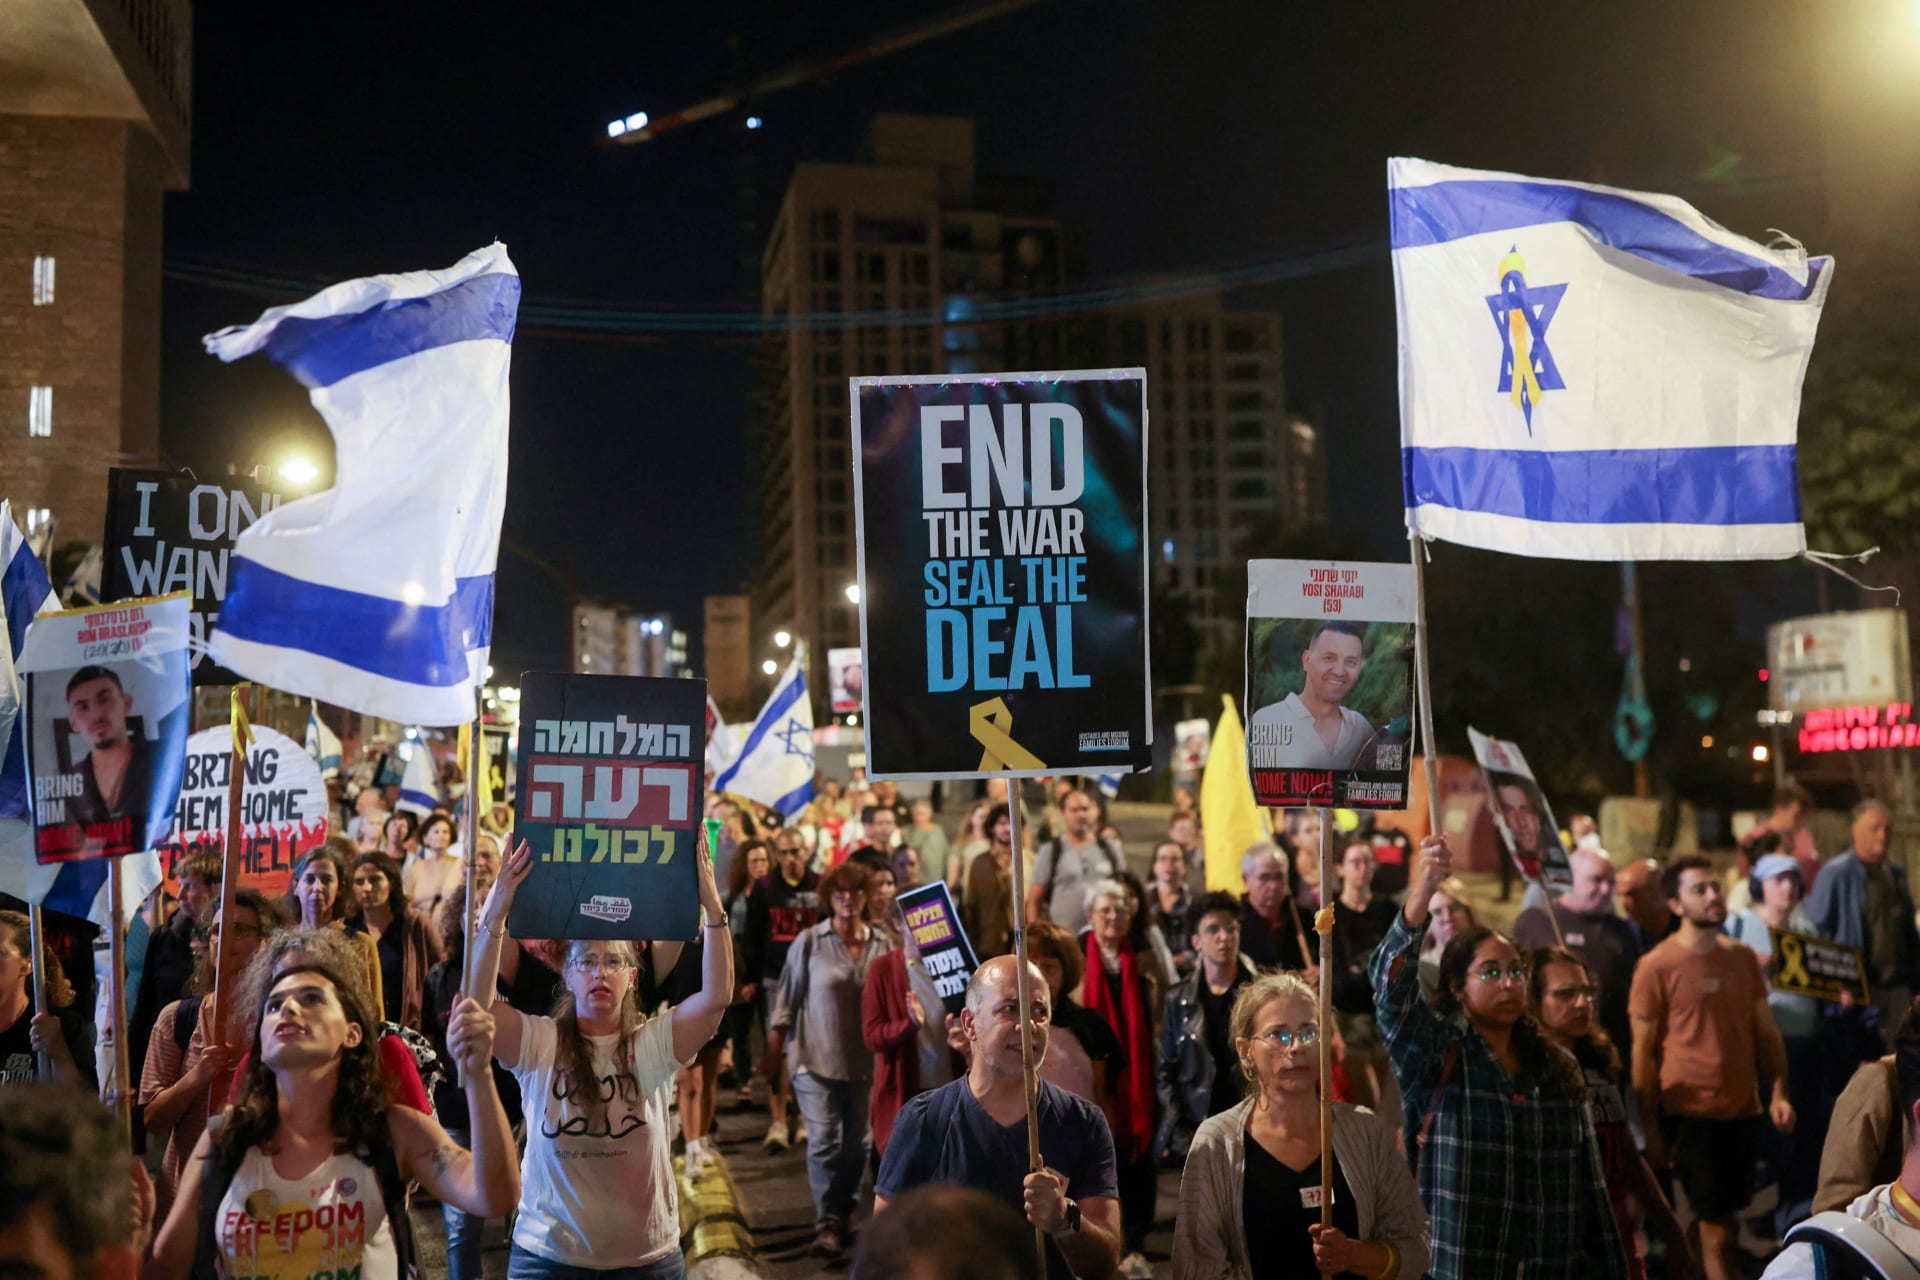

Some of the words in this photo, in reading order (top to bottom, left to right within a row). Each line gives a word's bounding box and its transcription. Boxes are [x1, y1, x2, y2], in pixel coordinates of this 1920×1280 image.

[920, 402, 1085, 510] END
[133, 481, 160, 537] I
[188, 484, 281, 541] ON
[922, 510, 991, 558] THE
[997, 508, 1086, 556] WAR
[120, 540, 234, 601] WAN
[923, 558, 1014, 607] SEAL
[1020, 556, 1088, 603] THE
[1302, 583, 1323, 597] YOSI
[1324, 584, 1365, 599] SHARABI
[1310, 568, 1339, 583] שרעבי
[1341, 569, 1358, 583] יוסי
[1323, 598, 1342, 614] (53)
[925, 604, 1092, 693] DEAL
[534, 714, 691, 758] המלחמה
[1252, 722, 1293, 746] BRING
[182, 748, 279, 791] BRING
[1253, 745, 1277, 768] HIM
[36, 772, 84, 800] BRING
[531, 764, 689, 821] רעה
[1254, 771, 1287, 794] HOME
[1290, 770, 1333, 796] NOW!
[1347, 789, 1377, 800] FAMILIES
[1379, 790, 1402, 801] FORUM
[37, 799, 66, 826] HIM
[173, 795, 223, 834] HEM
[240, 789, 308, 825] HOME
[541, 823, 676, 865] לכולנו.
